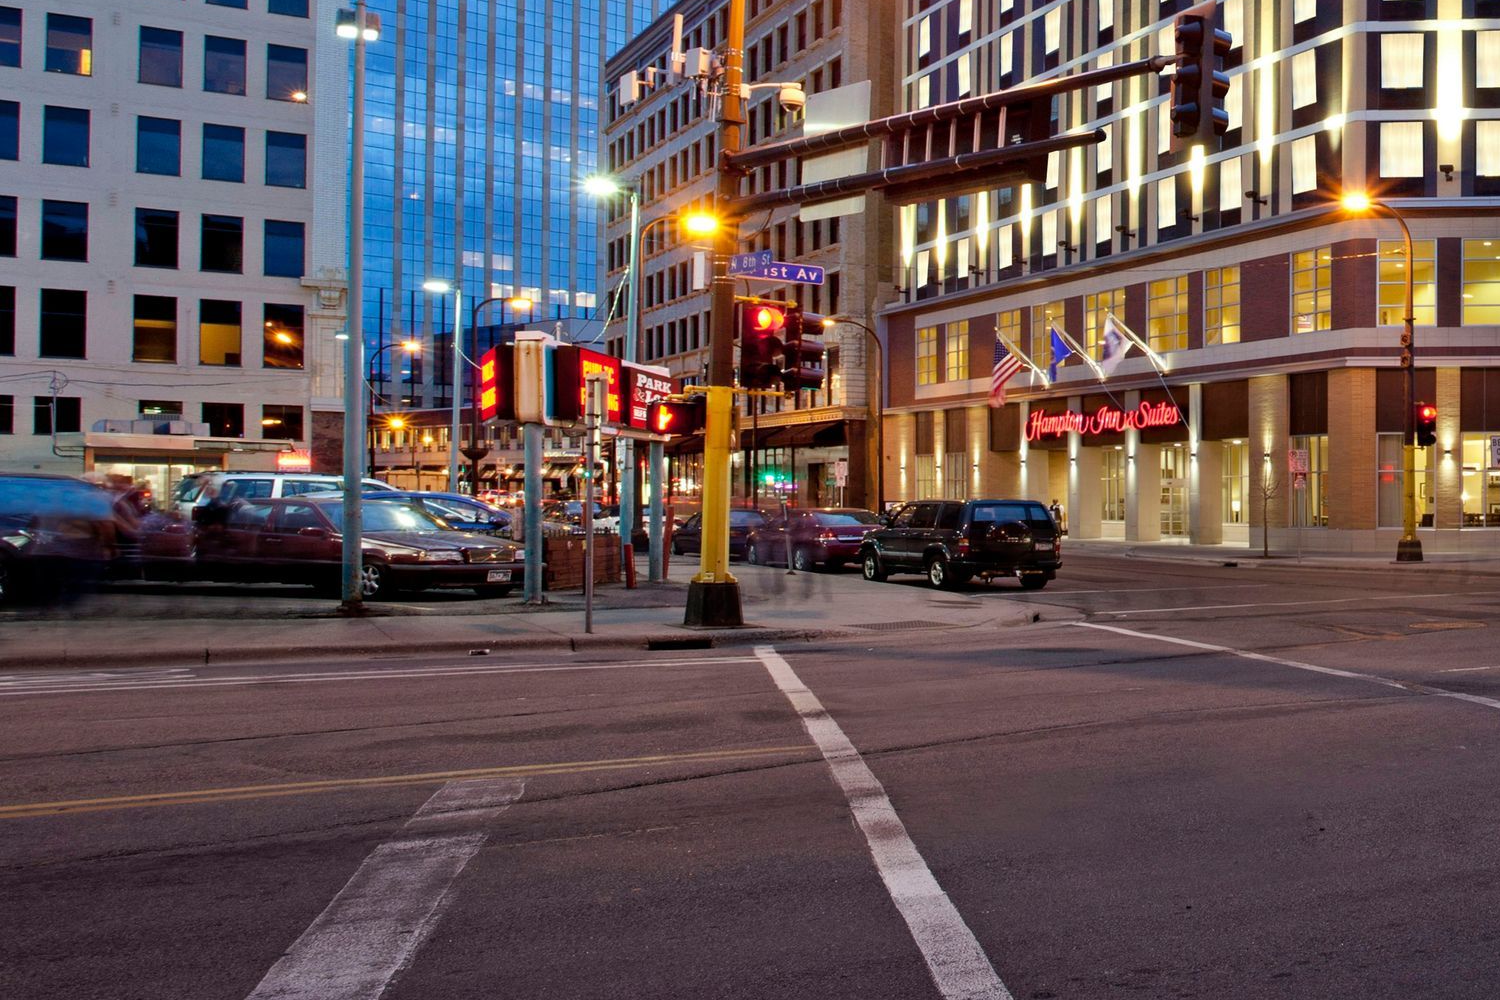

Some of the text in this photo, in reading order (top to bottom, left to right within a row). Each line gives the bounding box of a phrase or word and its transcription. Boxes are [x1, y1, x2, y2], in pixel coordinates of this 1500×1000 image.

[742, 256, 757, 268] 8th
[761, 253, 771, 266] St
[797, 268, 817, 280] Av
[636, 373, 671, 394] PARK
[645, 390, 669, 405] LO
[1024, 409, 1089, 441] Hampton
[1090, 404, 1127, 435] Inn
[1134, 401, 1179, 429] Suites
